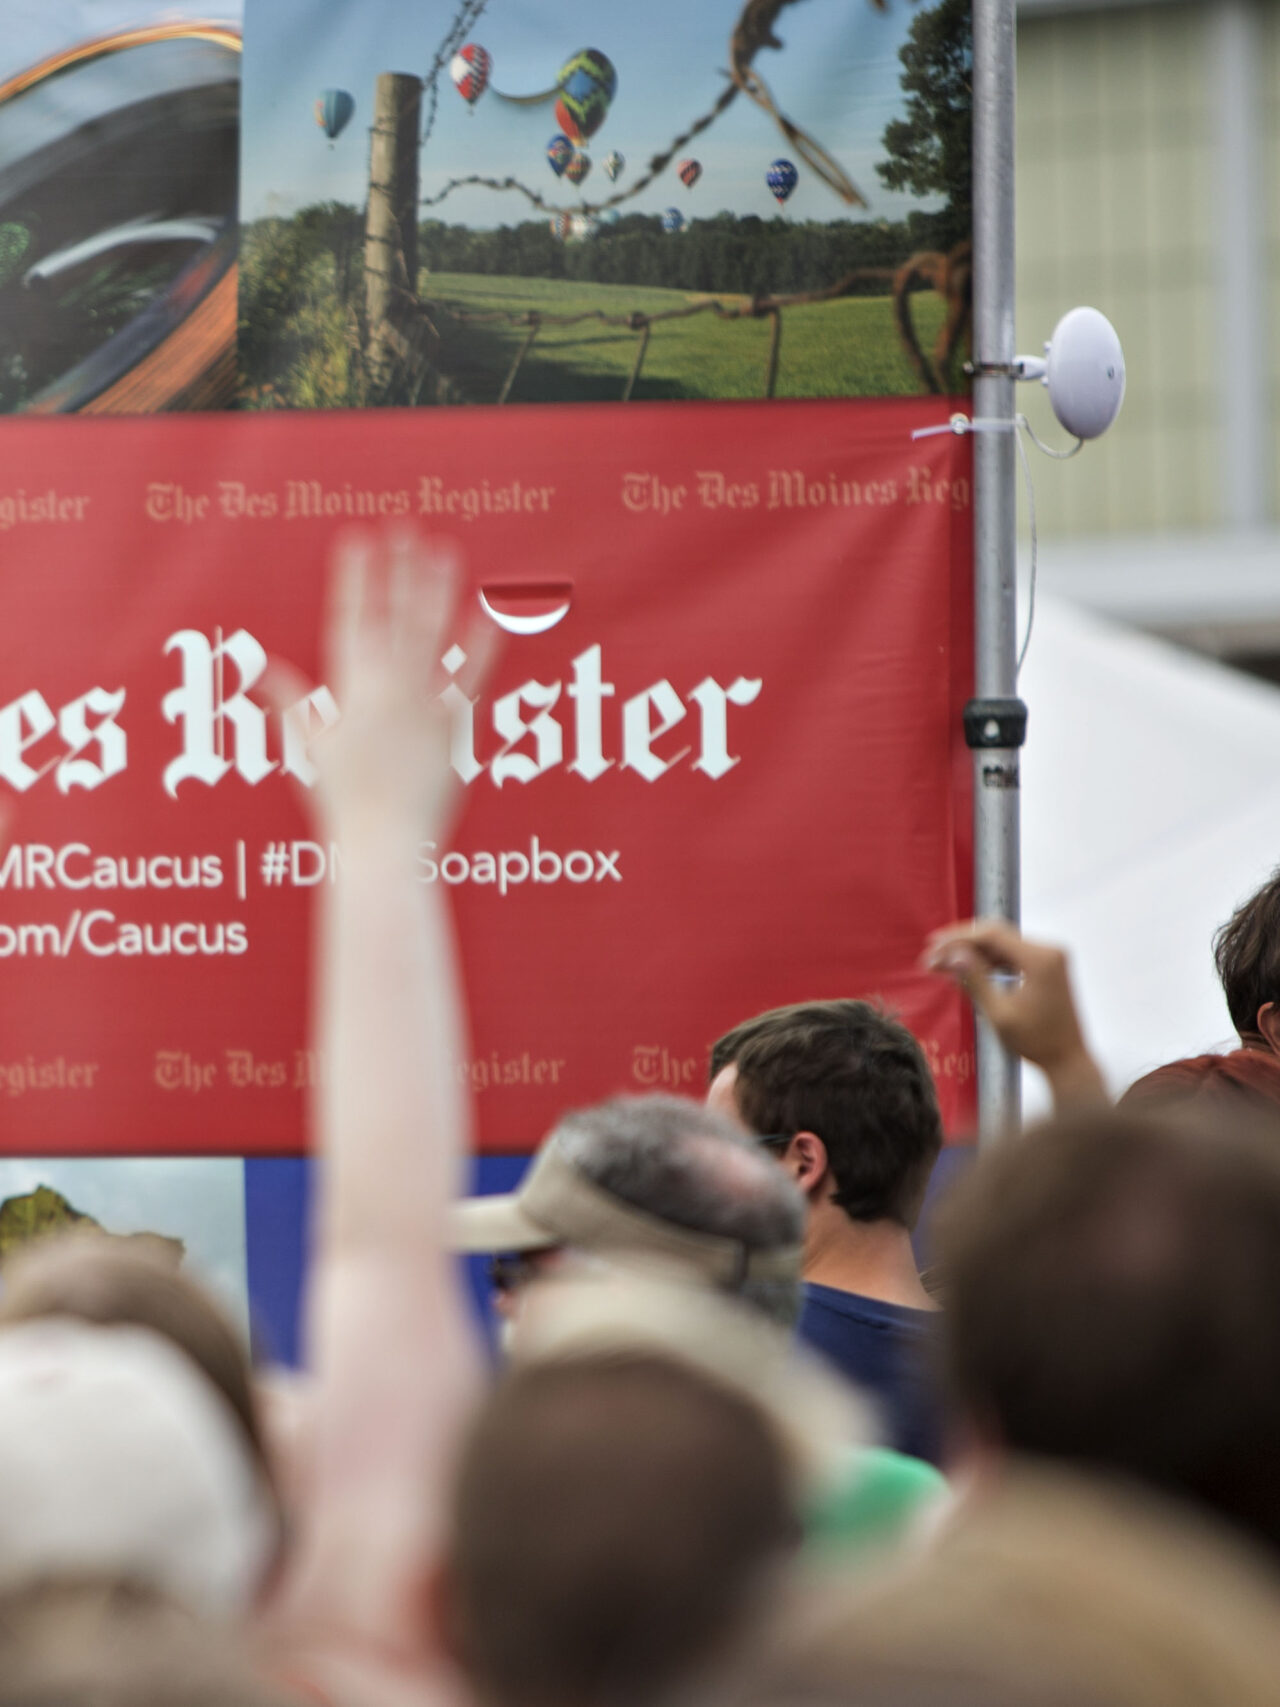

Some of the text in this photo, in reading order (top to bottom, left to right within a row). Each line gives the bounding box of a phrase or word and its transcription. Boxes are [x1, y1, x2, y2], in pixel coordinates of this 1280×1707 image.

[145, 476, 555, 524] The Des Moines Register
[622, 465, 970, 515] The Des Moines Reg
[163, 626, 763, 800] Reister
[154, 1050, 216, 1093] The
[225, 1049, 287, 1089] Des
[455, 1050, 565, 1092] egister
[632, 1044, 698, 1088] The
